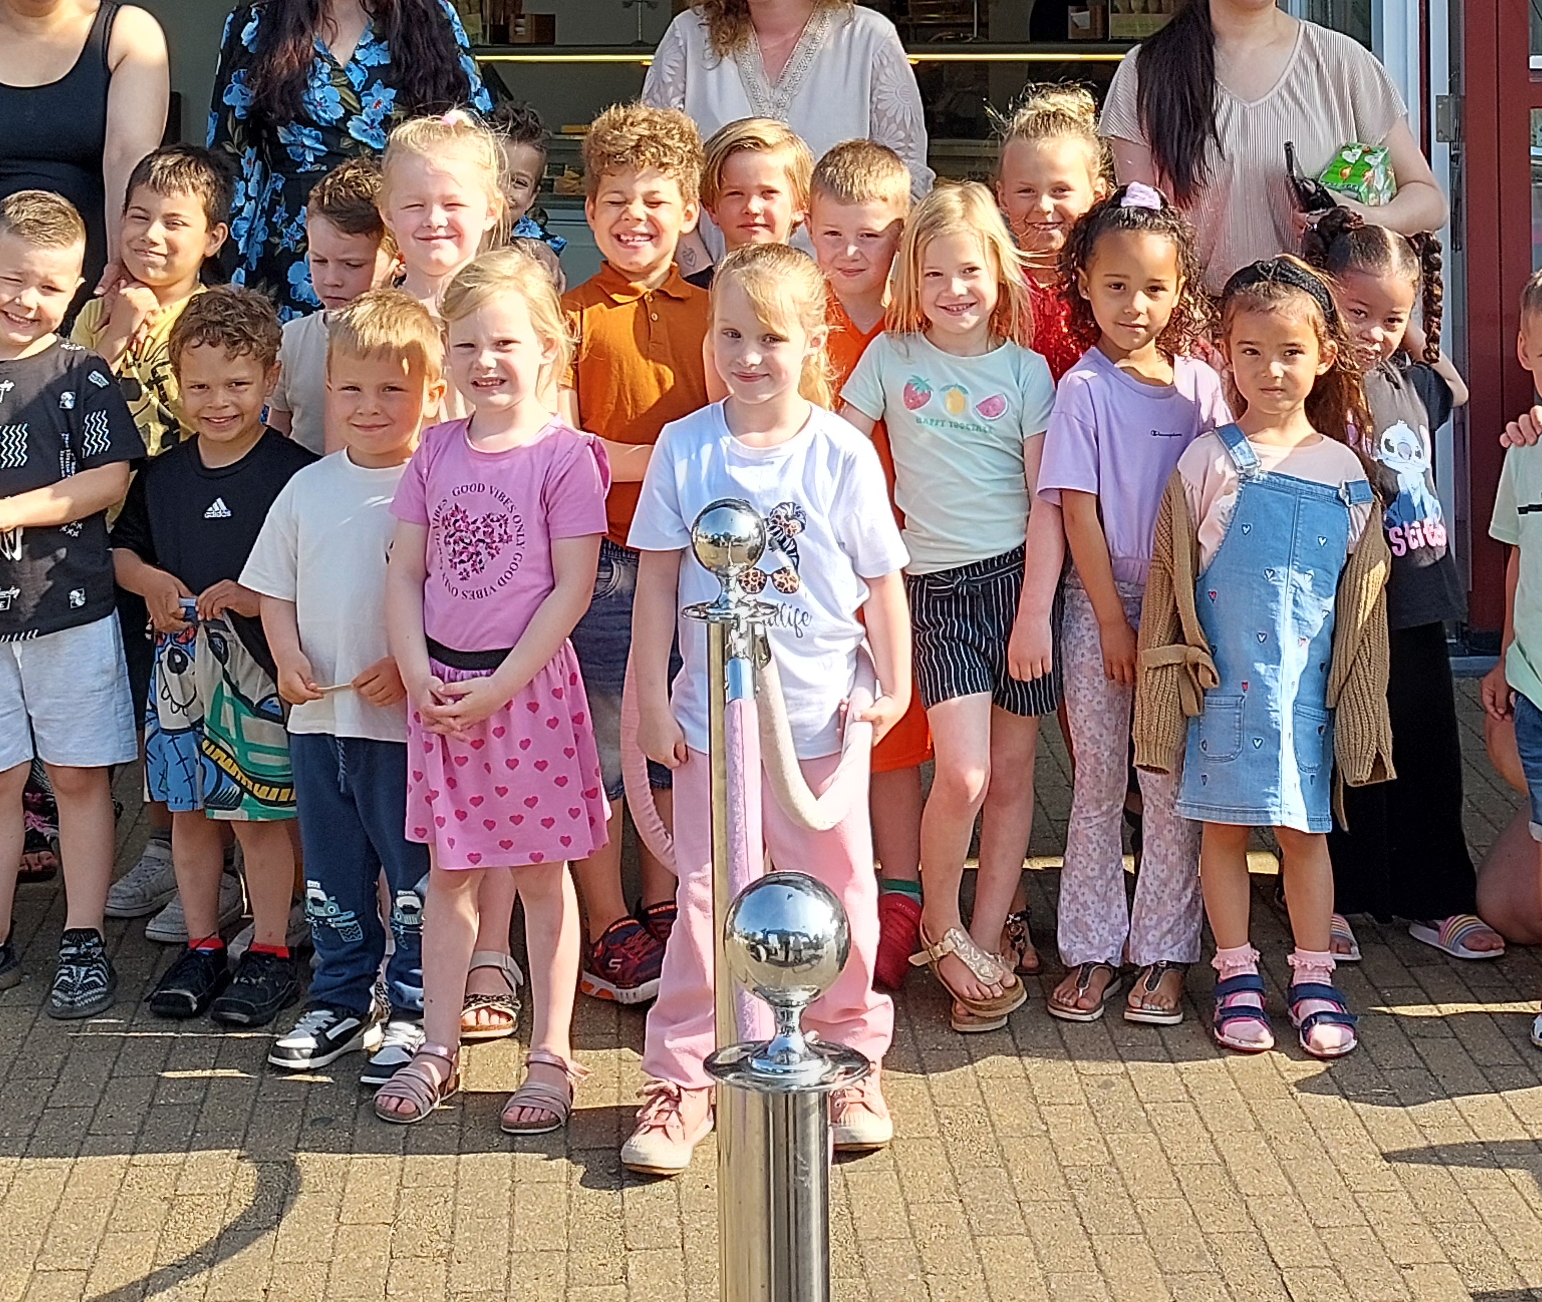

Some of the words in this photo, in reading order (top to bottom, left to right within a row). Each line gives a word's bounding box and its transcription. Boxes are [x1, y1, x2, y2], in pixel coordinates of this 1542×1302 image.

[452, 483, 486, 497] GOOD
[489, 485, 516, 513] VIBES
[512, 514, 526, 549] ONLY
[497, 552, 523, 587] GOOD
[461, 585, 497, 600] VIBES
